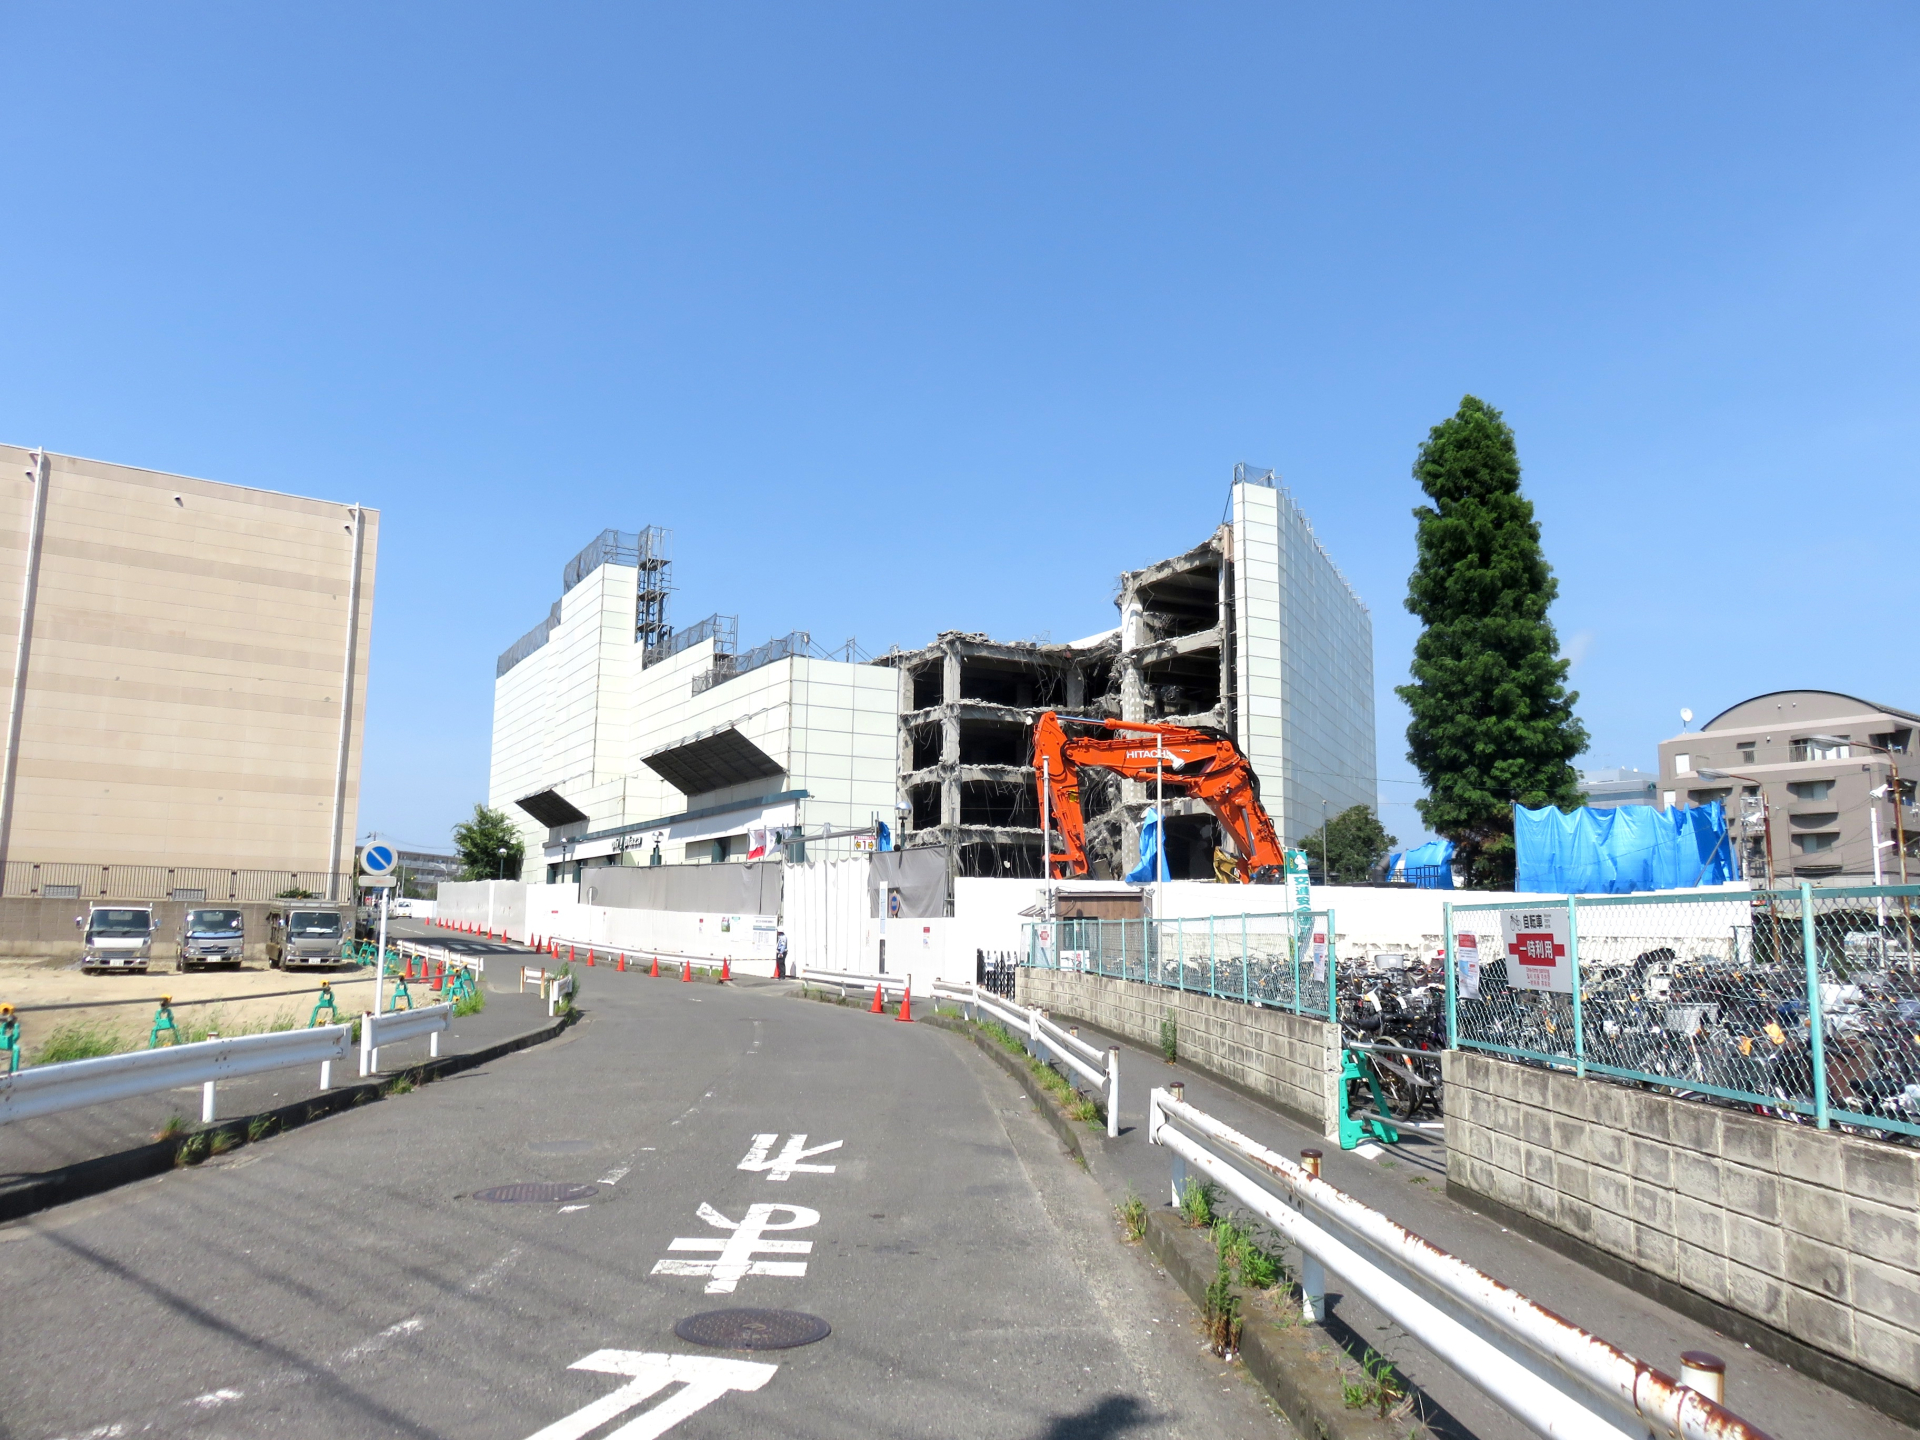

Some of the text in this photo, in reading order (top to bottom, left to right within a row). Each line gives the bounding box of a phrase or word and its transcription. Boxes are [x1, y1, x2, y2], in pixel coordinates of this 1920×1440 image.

[1523, 914, 1543, 929] 自転車
[1519, 940, 1553, 959] 一時利用
